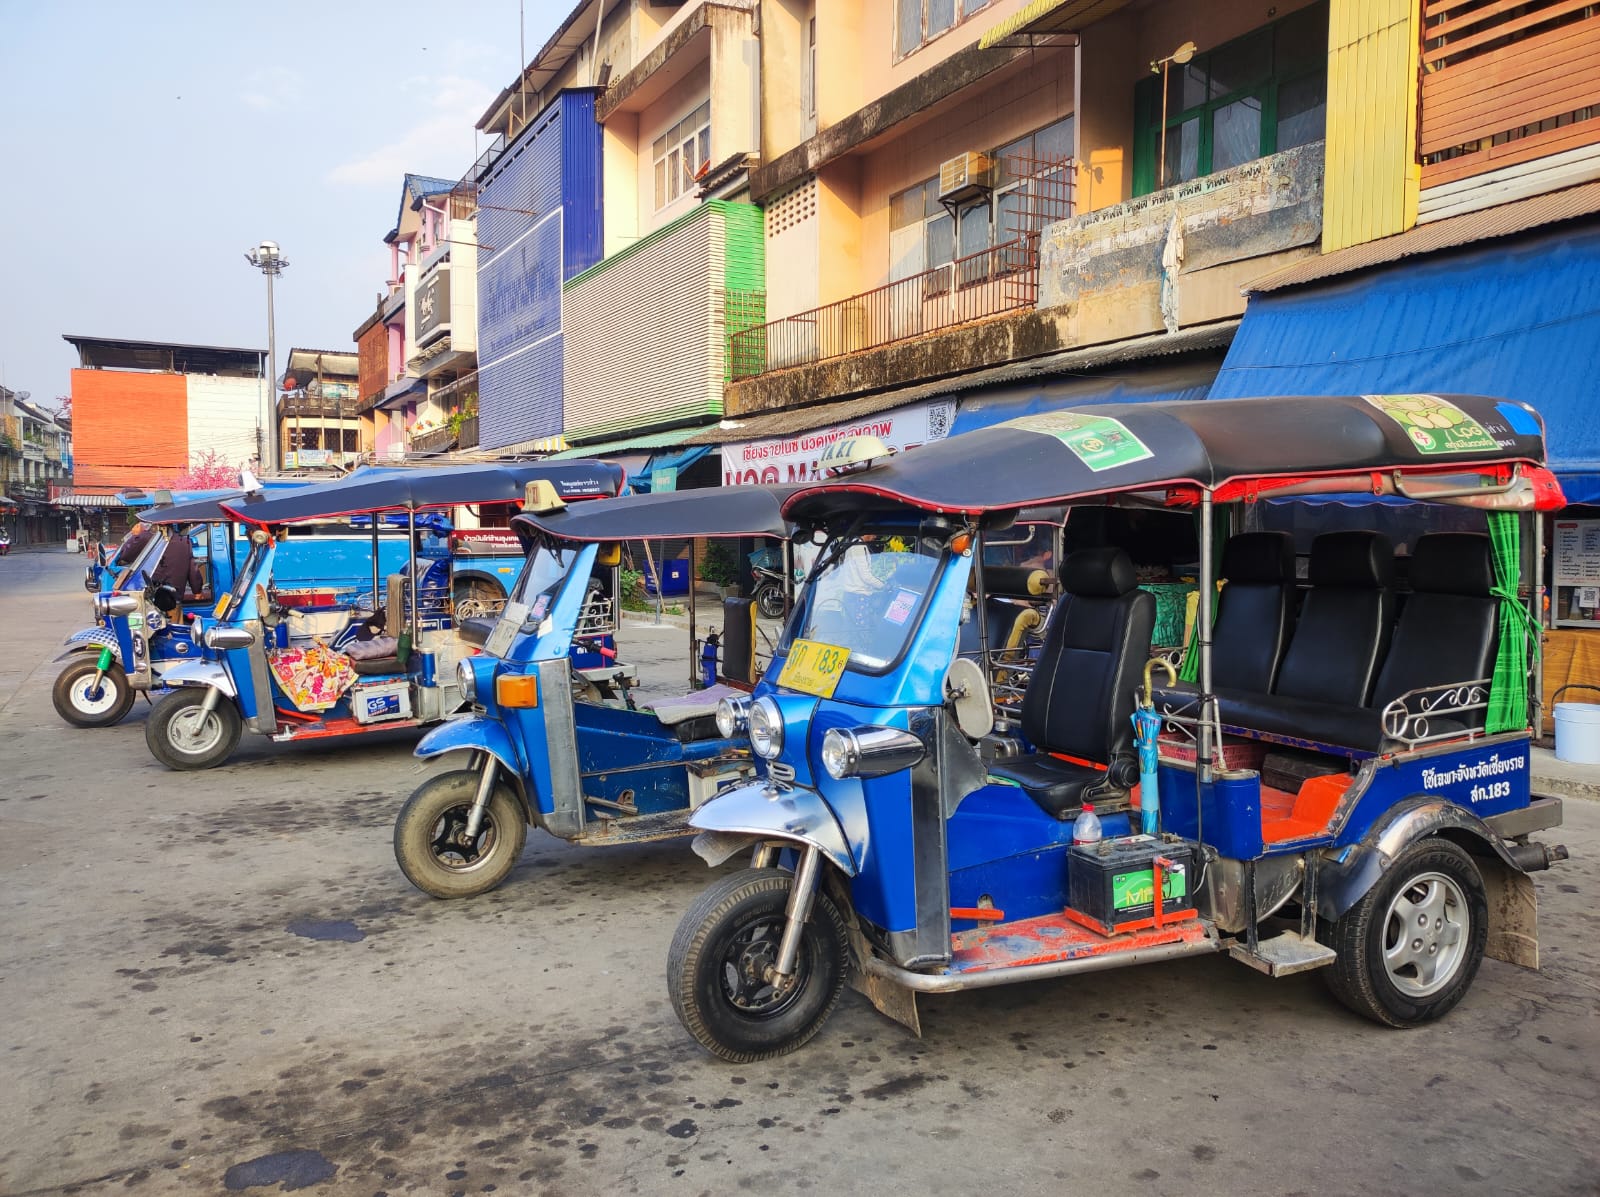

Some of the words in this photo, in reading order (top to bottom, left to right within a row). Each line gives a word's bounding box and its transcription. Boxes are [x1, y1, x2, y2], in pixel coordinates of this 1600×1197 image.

[812, 648, 839, 673] 183
[367, 697, 386, 710] GS
[1421, 753, 1525, 790] ใช้เฉพาะจังหวัดเชียงราย
